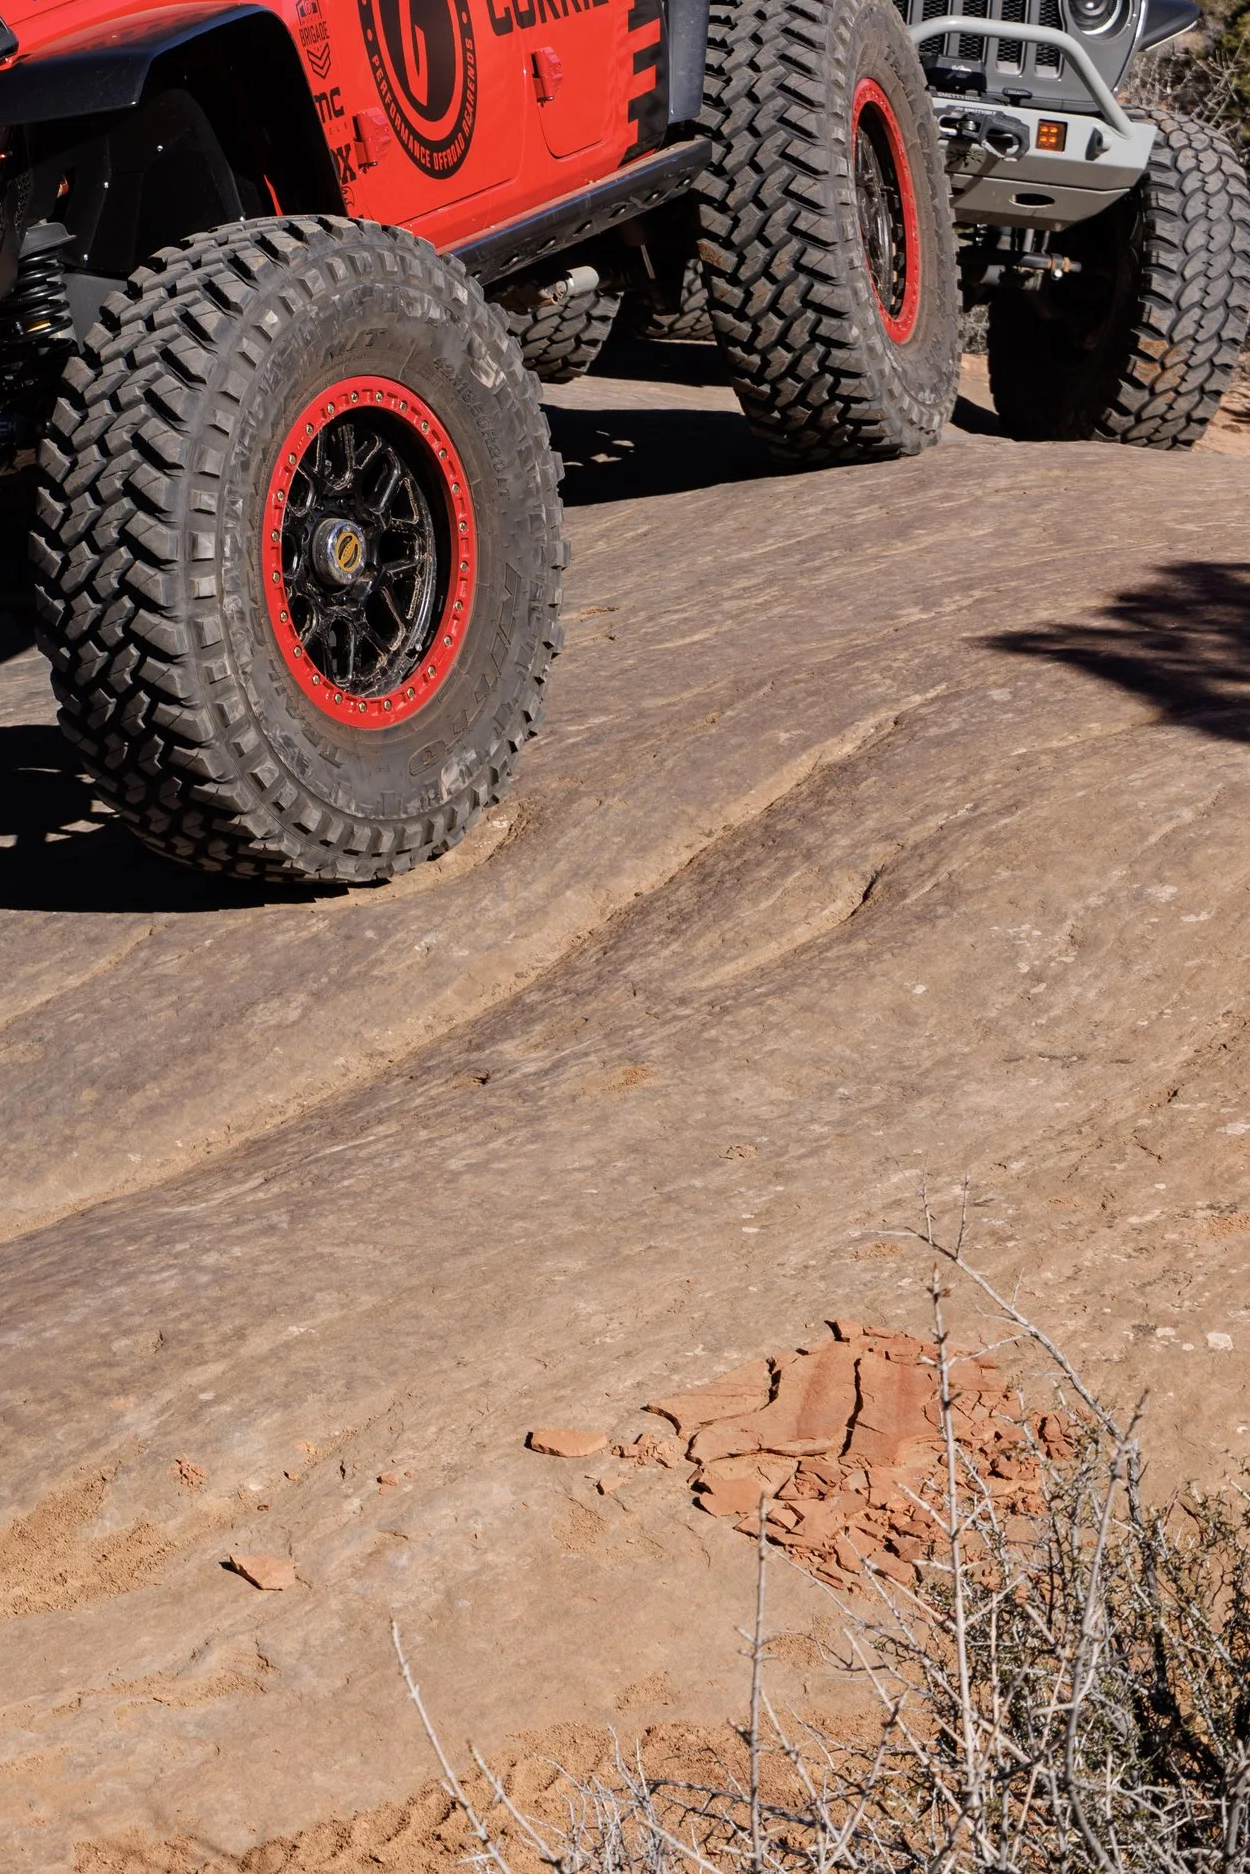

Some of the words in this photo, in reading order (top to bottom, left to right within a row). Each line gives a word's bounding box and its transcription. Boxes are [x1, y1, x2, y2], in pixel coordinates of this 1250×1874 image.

[299, 21, 330, 48] BRIGADE
[371, 54, 432, 168] PERFORMANCE
[432, 132, 465, 171] OFFROAD
[461, 37, 475, 138] REARENDS
